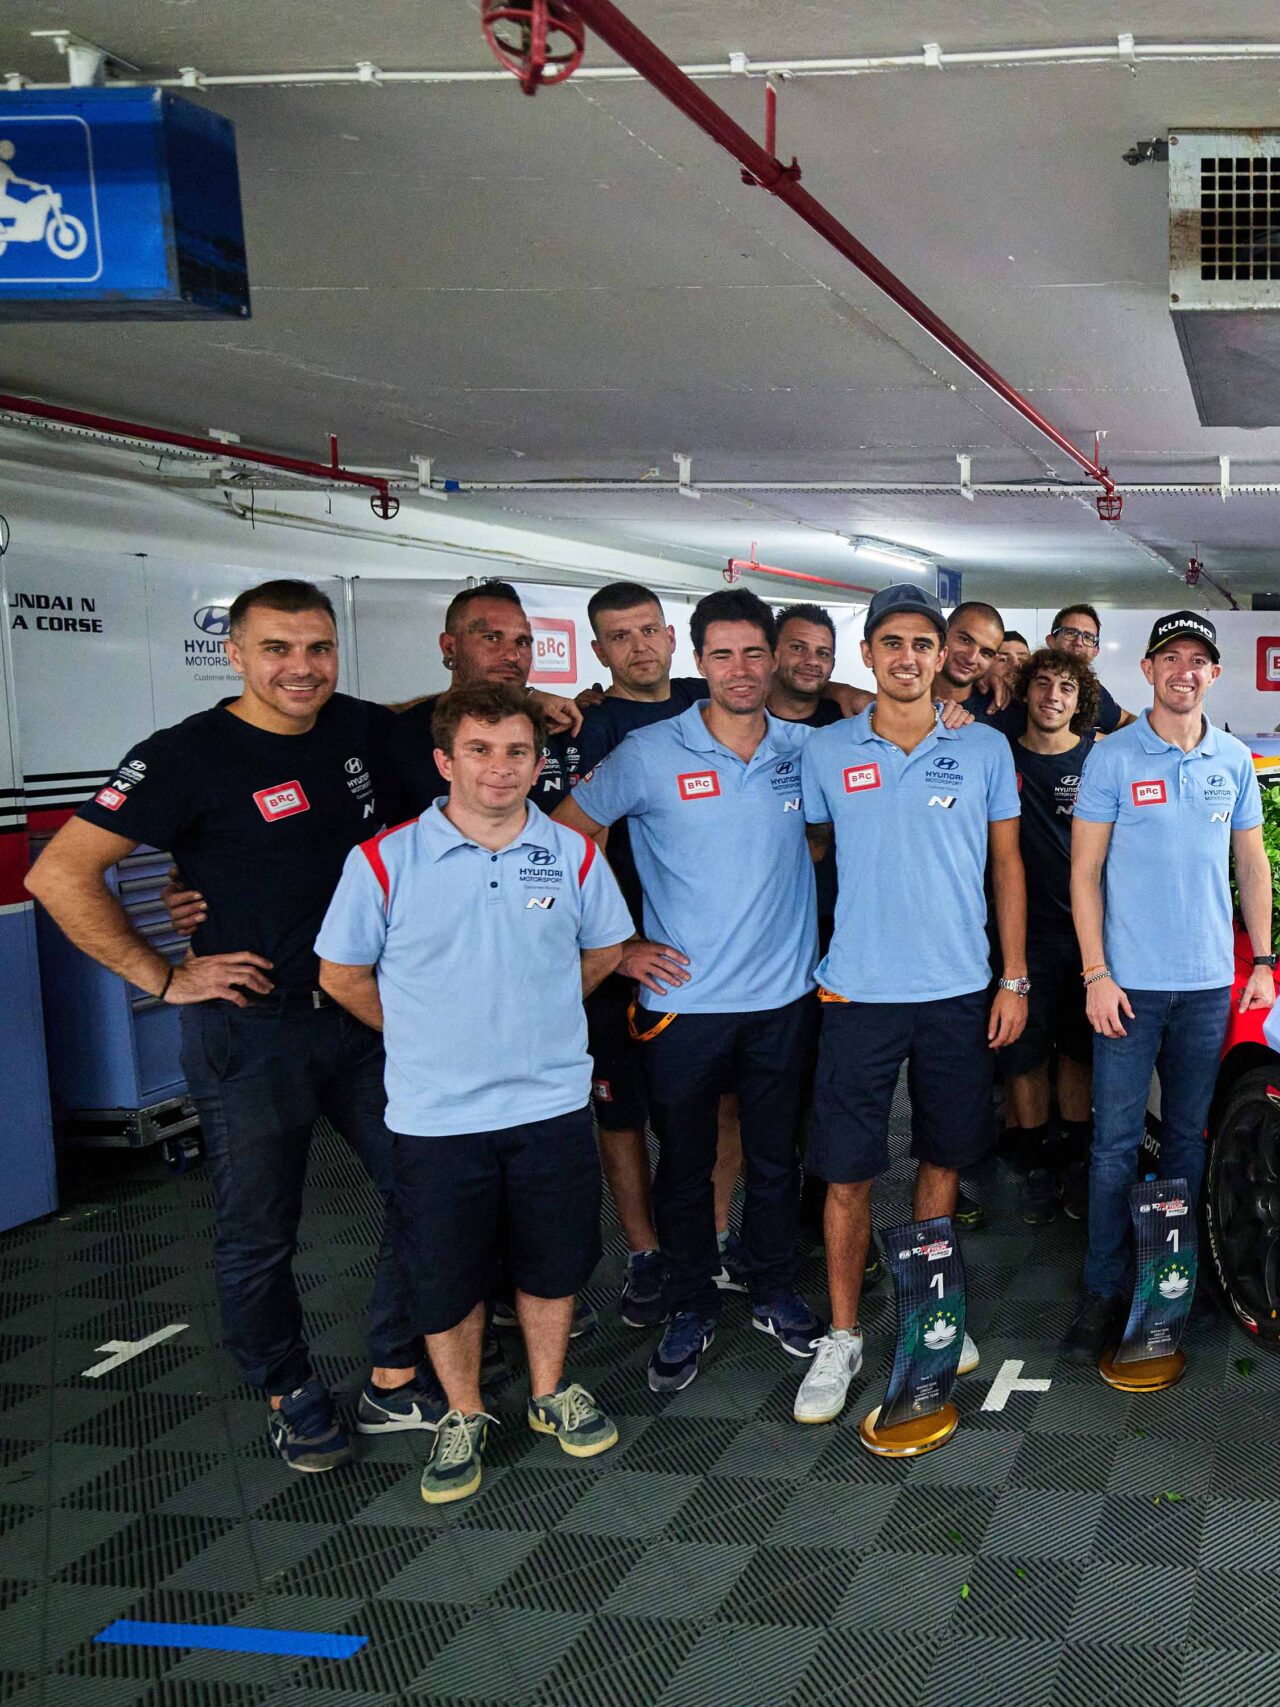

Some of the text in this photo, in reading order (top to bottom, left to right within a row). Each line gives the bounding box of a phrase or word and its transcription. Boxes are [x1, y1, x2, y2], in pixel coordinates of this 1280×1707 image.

[80, 598, 95, 612] N
[36, 616, 104, 634] CORSE
[1158, 619, 1213, 639] KUMHO
[184, 639, 227, 653] HYUN
[537, 636, 566, 658] BRC
[851, 772, 872, 782] BRC
[925, 770, 963, 781] HYUNDAI
[688, 779, 710, 790] BRC
[1139, 787, 1159, 796] BRC
[269, 792, 295, 808] BRC
[1166, 1229, 1179, 1253] 1
[929, 1272, 944, 1299] 1
